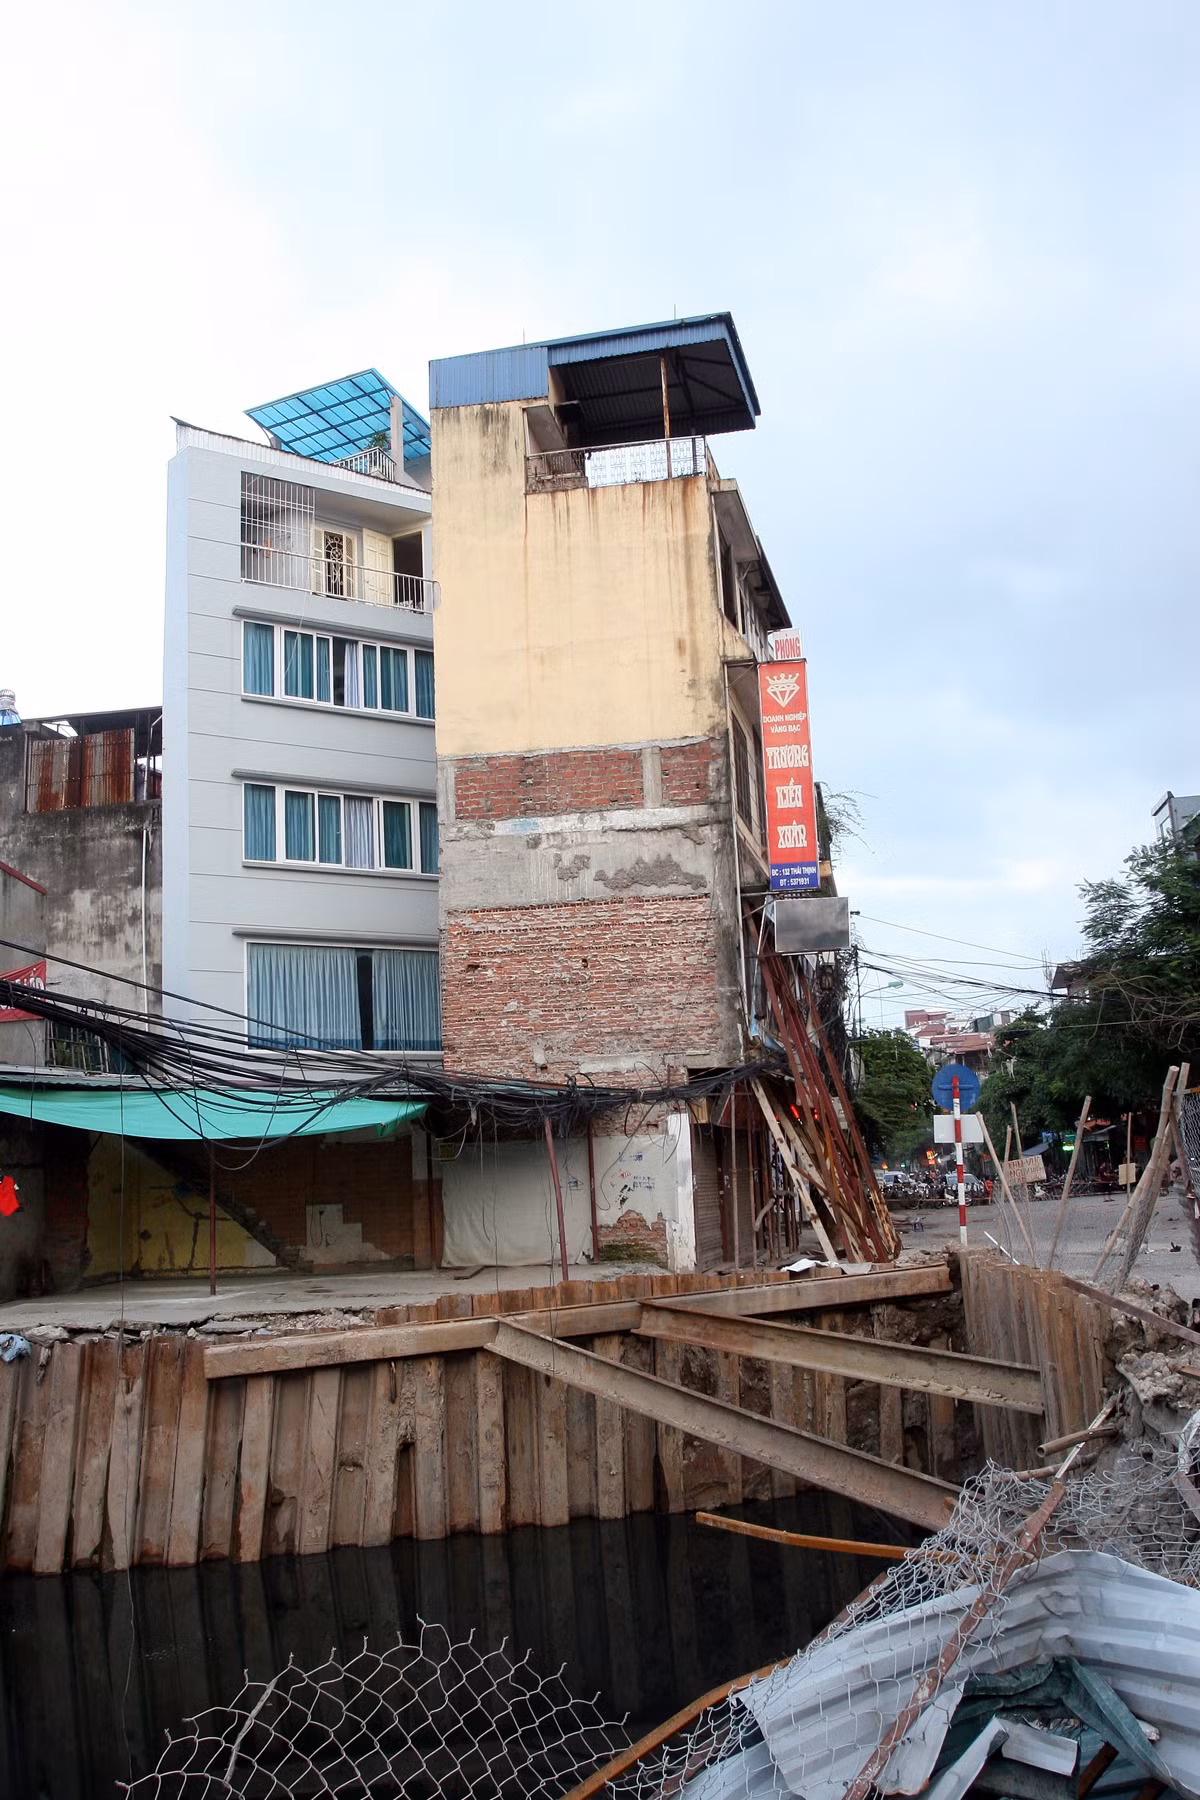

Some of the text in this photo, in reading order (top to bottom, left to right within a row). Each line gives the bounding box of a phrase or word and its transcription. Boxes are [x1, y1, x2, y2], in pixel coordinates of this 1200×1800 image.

[763, 711, 807, 723] DOANH NGHIỆP
[770, 724, 800, 734] VÀNG BẠC
[777, 819, 807, 848] XUÂN
[802, 866, 816, 875] THỊNH
